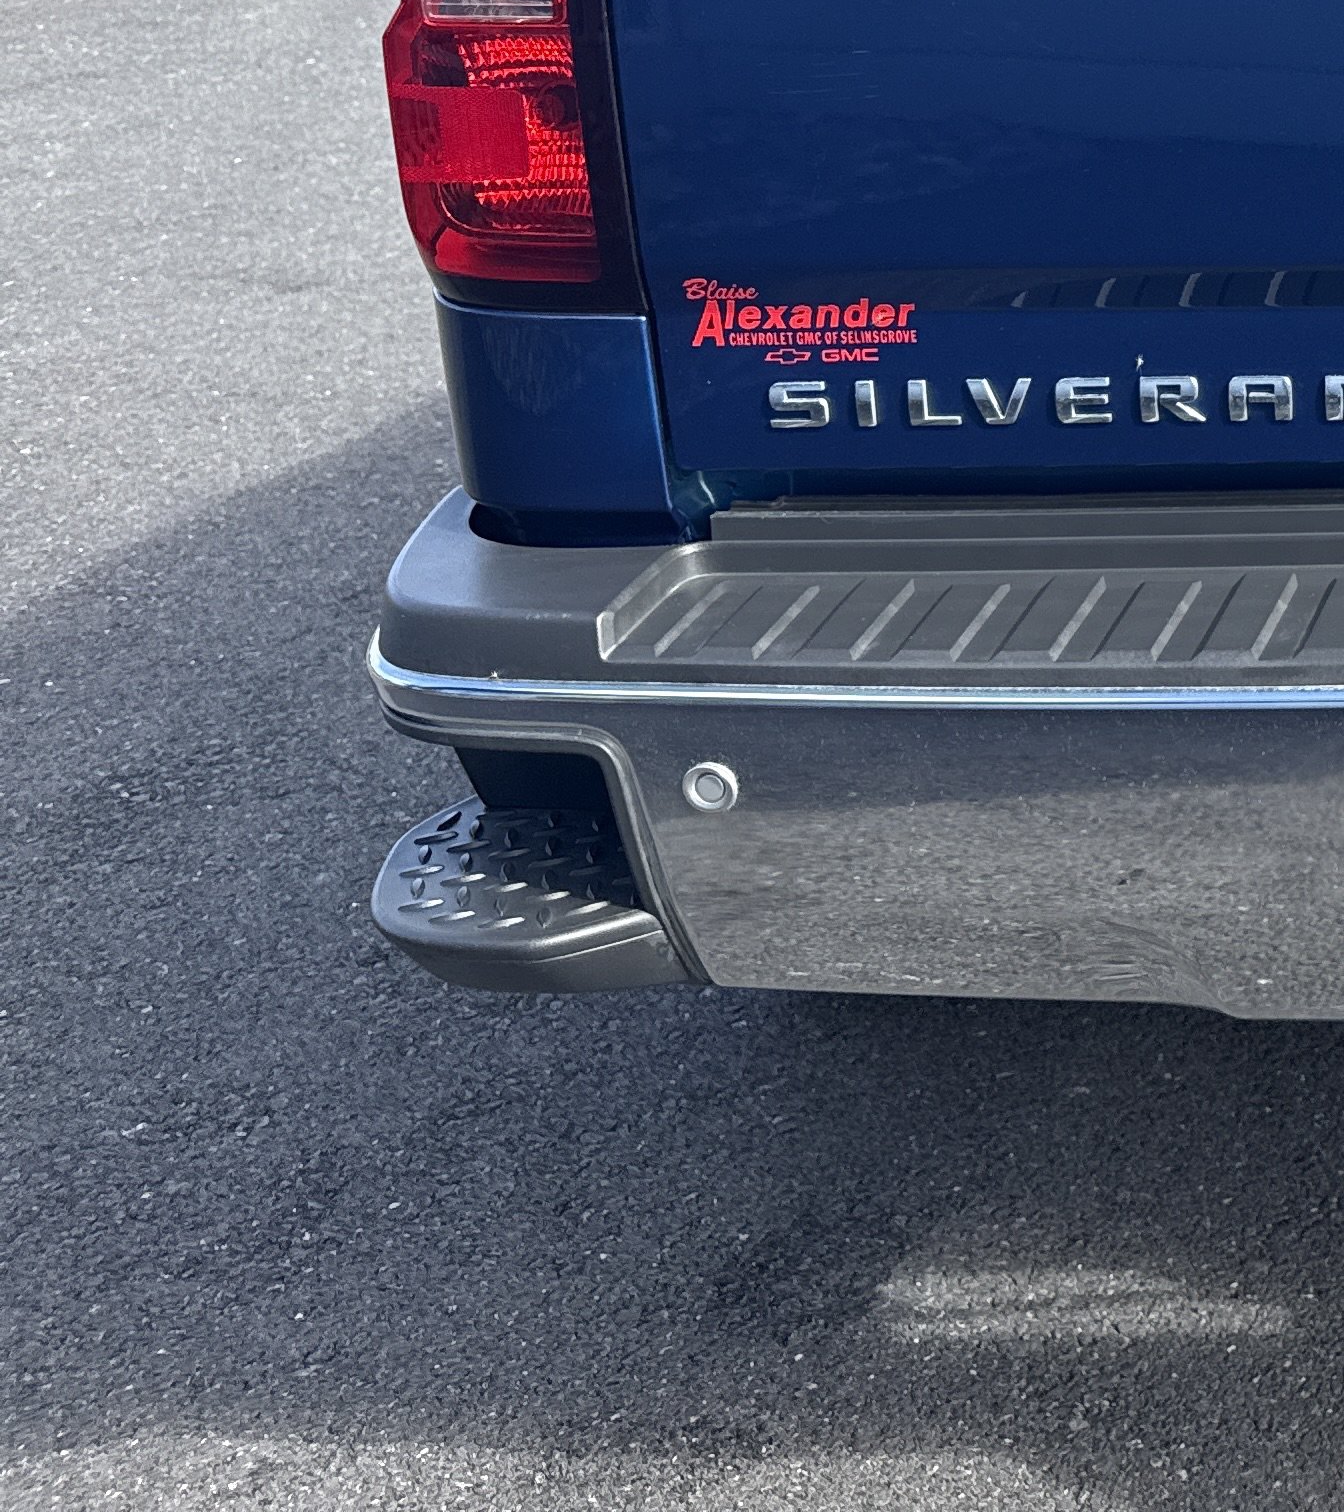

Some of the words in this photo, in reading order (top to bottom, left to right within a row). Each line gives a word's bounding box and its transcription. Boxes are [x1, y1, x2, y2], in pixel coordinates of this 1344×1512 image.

[682, 277, 760, 301] Blaise
[691, 297, 916, 347] Alexander
[729, 331, 794, 347] CHEVROLET
[796, 331, 822, 346] GMC
[824, 331, 839, 345] OF
[839, 329, 918, 345] SELINSGROVE
[821, 348, 880, 363] GMC
